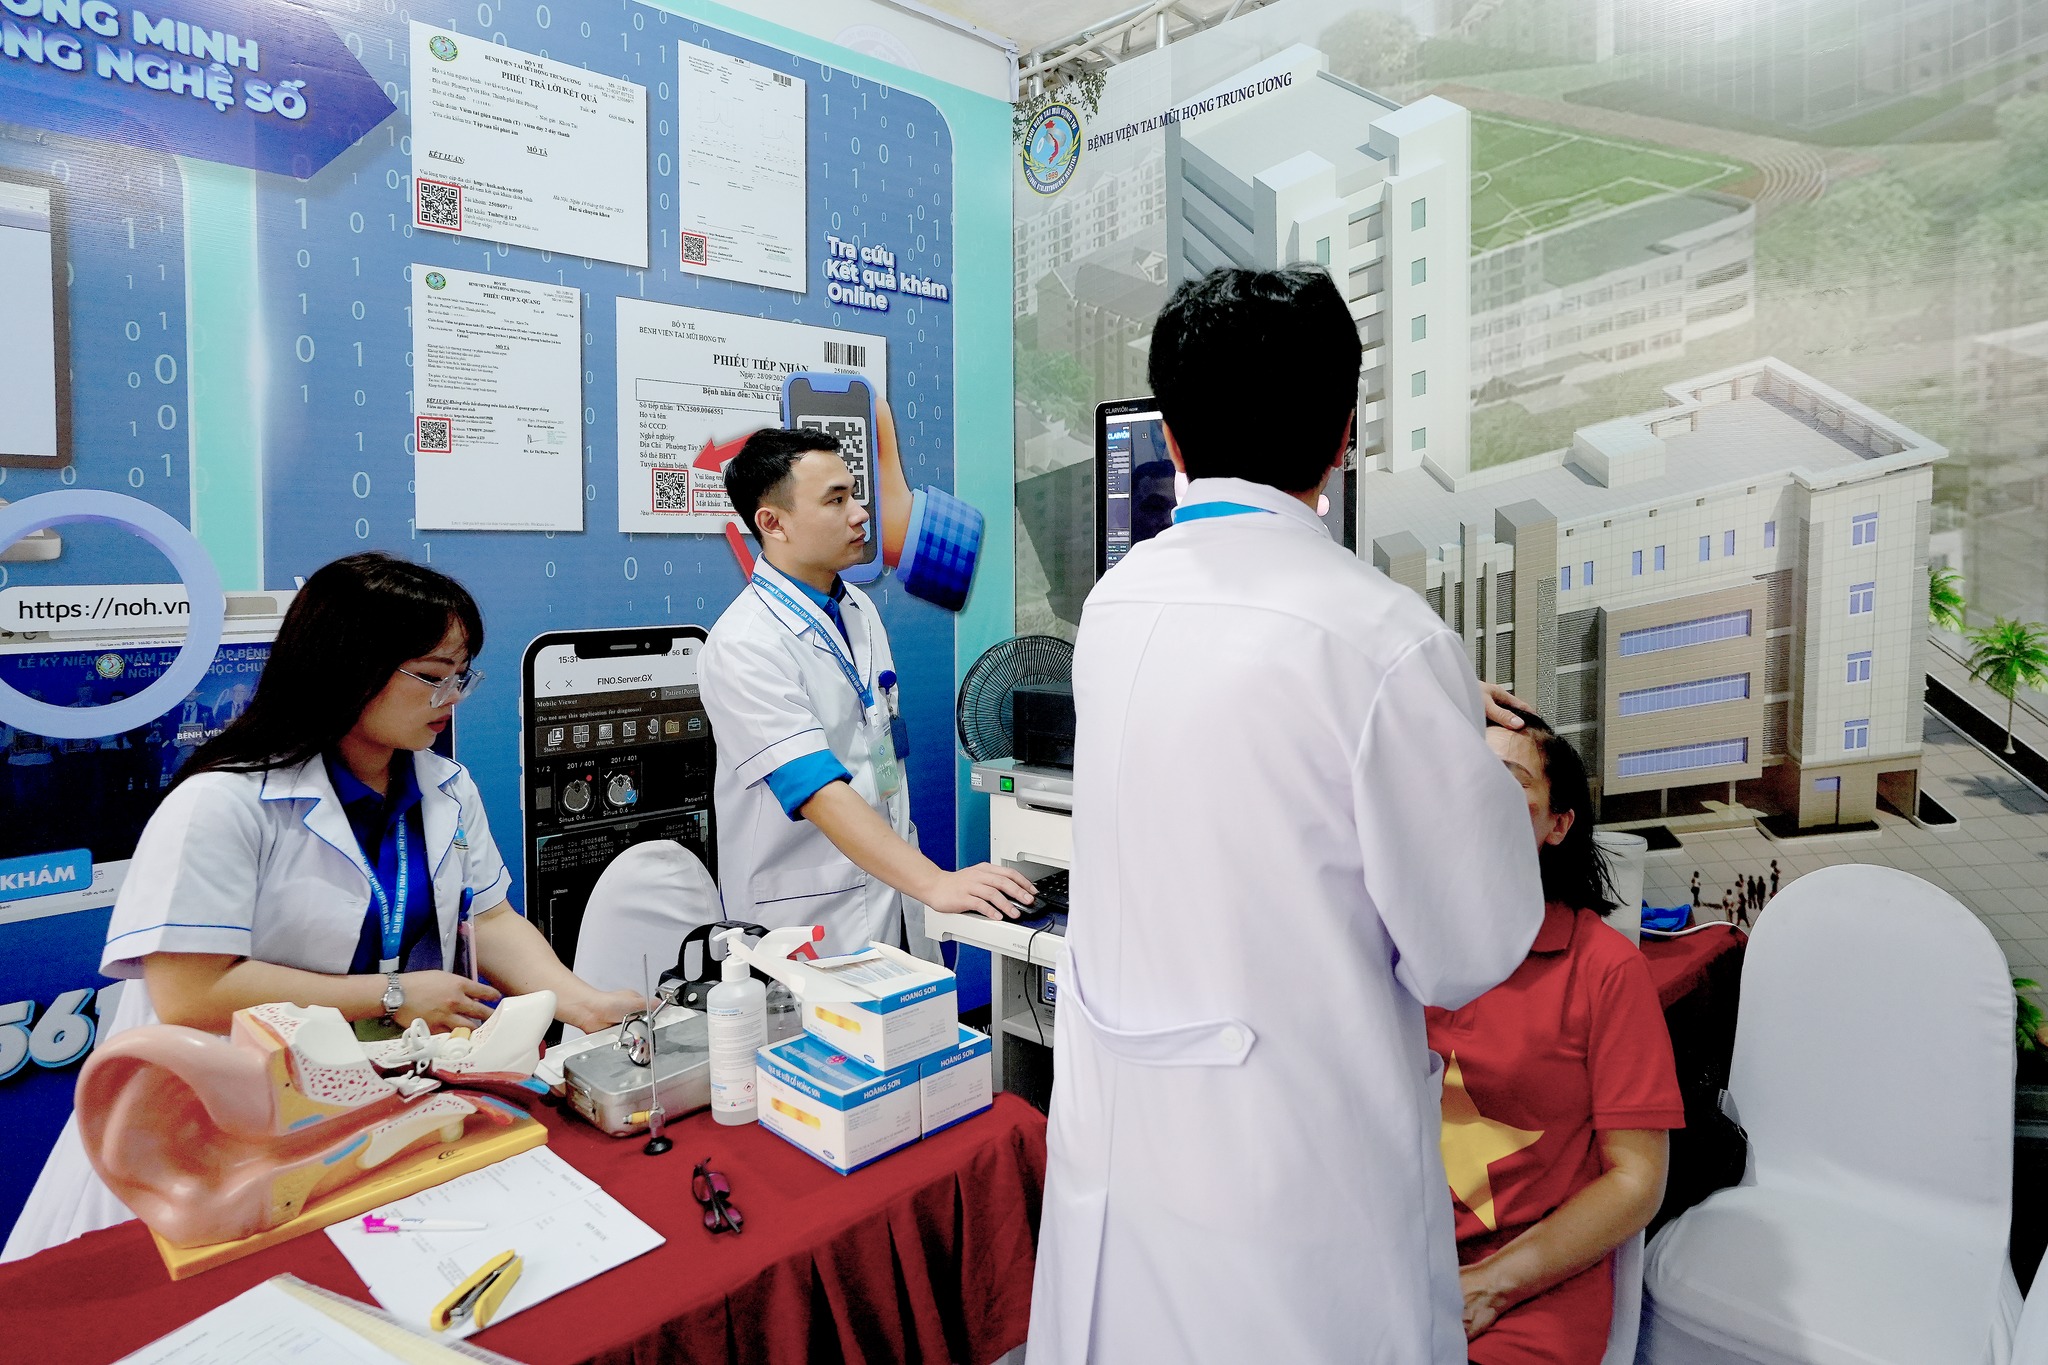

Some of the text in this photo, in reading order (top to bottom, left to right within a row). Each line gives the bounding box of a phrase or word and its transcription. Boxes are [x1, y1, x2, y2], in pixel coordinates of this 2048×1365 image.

[132, 9, 259, 72] MINH
[0, 21, 307, 120] NG NGHỆ SỐ
[502, 71, 528, 84] PHIẾU
[529, 78, 546, 90] TRẢ
[563, 86, 579, 99] KẾT
[1087, 72, 1292, 152] BỆNH VIỆN TAI MŨI HỌNG TRUNG ƯƠNG
[827, 236, 896, 268] Tra cứu
[827, 258, 948, 300] Kết quả khám
[828, 282, 889, 310] Online
[713, 353, 749, 368] PHIẾU
[752, 356, 776, 371] TIẾP
[19, 597, 190, 622] https://noh.vn
[125, 652, 155, 663] NĂM
[558, 656, 578, 664] 15:31
[598, 674, 653, 686] FINO.Server.GX
[177, 731, 202, 741] BỆNH
[0, 864, 76, 891] KHÁM
